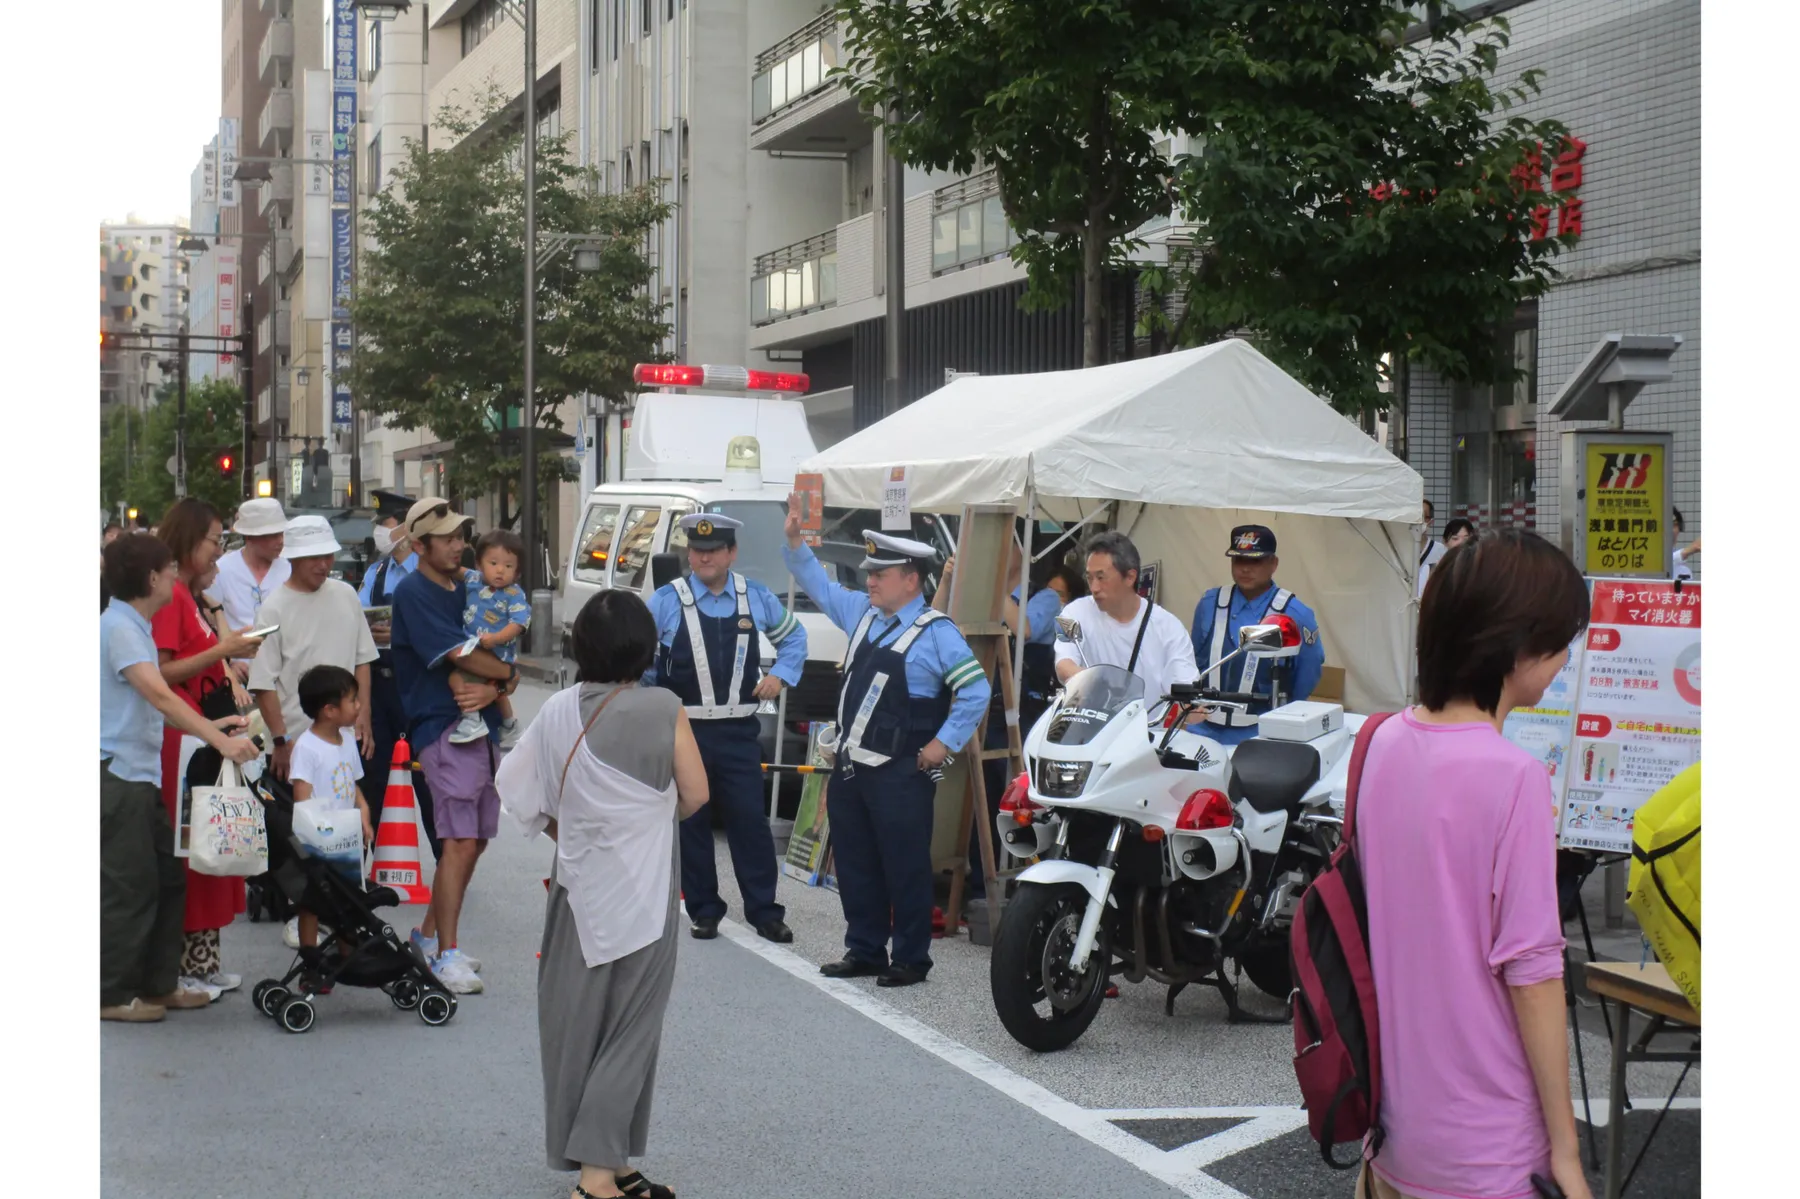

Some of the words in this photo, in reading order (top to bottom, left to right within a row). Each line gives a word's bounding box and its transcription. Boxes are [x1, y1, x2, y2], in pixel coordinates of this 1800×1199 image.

[1589, 519, 1657, 532] 浅草雷門前
[1598, 537, 1649, 551] はとバス
[1602, 554, 1644, 568] のりば
[1612, 588, 1700, 605] 持っていますか
[1628, 608, 1693, 624] マイ消火器
[1592, 634, 1610, 645] 効果
[1055, 707, 1109, 721] POLICE
[378, 871, 414, 884] 警視庁
